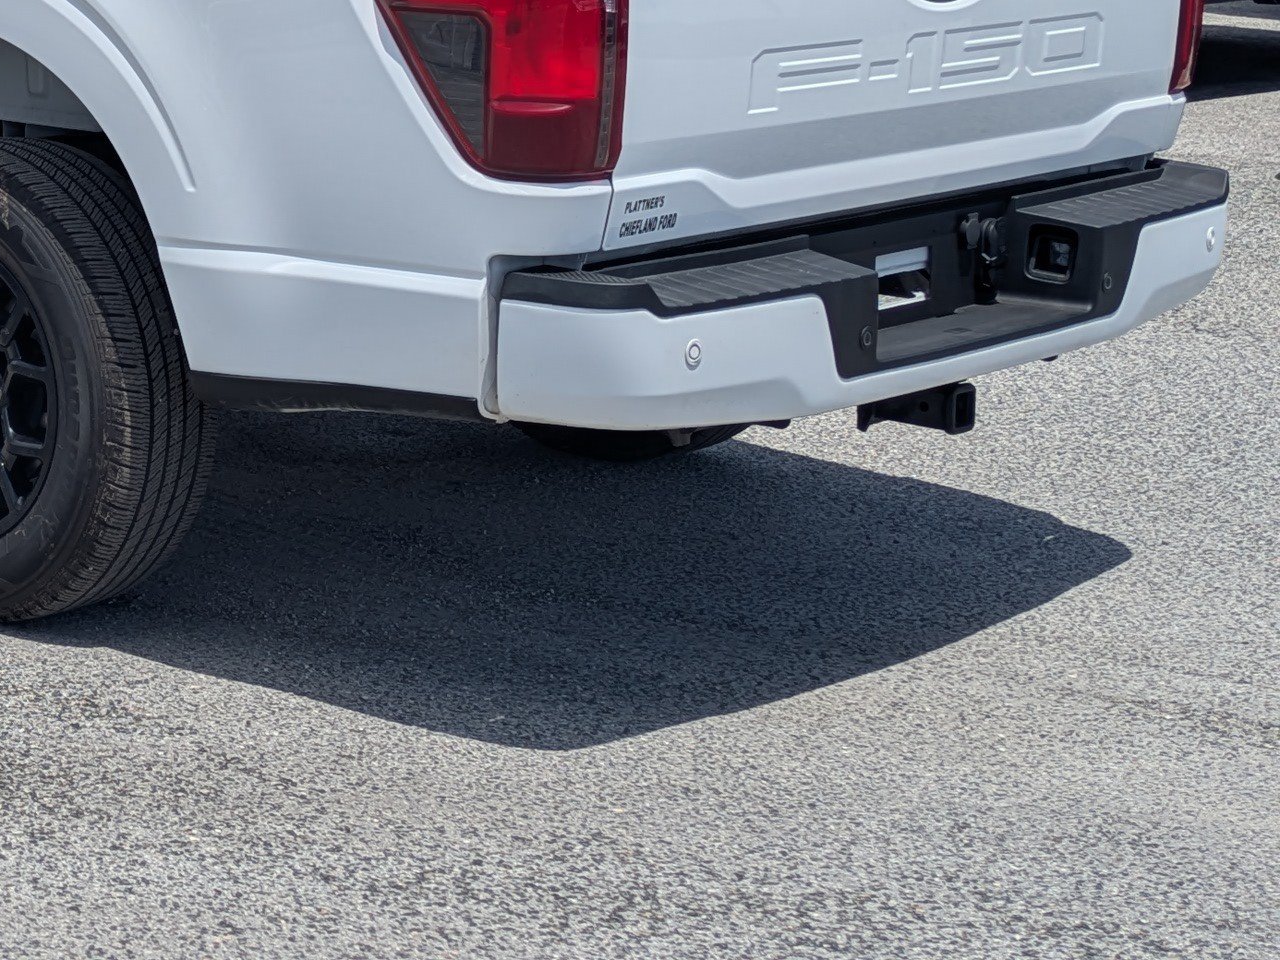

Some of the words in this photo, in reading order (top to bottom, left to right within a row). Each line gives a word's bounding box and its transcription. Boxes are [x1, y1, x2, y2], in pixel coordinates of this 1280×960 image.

[747, 10, 1105, 115] F-150
[624, 195, 666, 215] PLATTNER'S
[619, 216, 659, 238] CHIEFLAND
[657, 212, 678, 231] FORD
